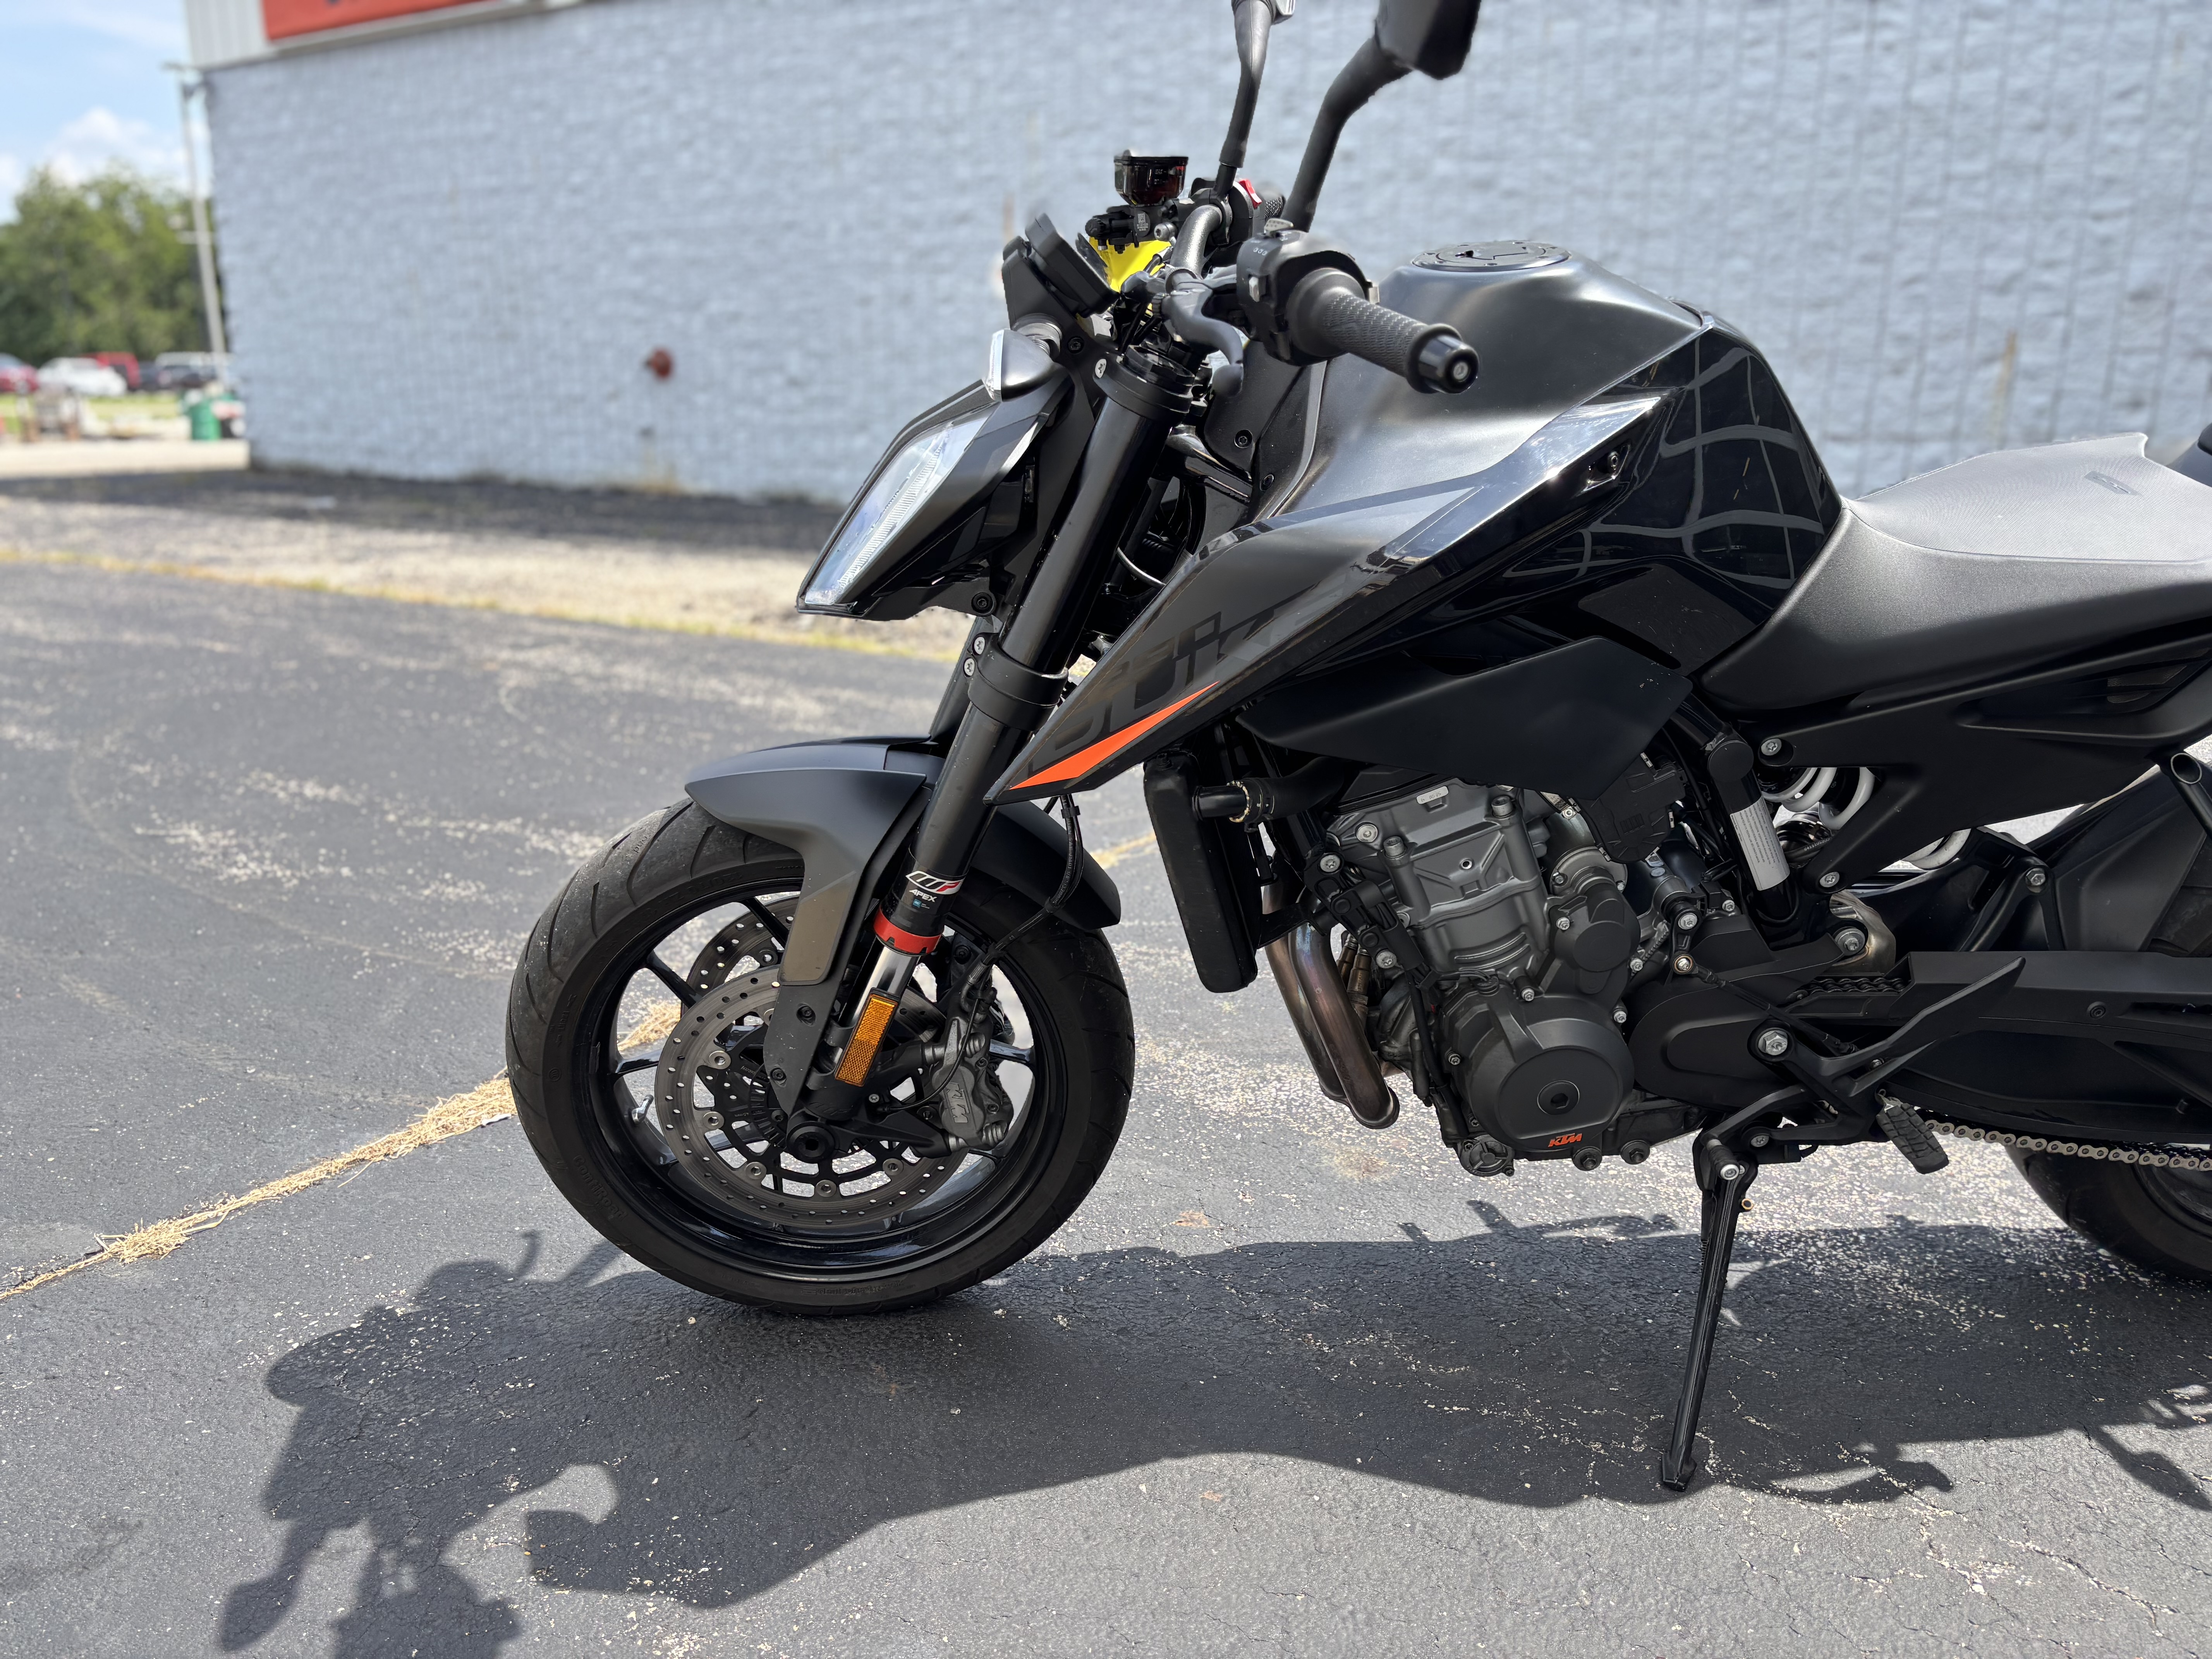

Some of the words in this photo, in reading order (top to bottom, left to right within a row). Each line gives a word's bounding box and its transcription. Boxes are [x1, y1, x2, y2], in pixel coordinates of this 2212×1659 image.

[909, 889, 938, 903] APEX
[945, 1082, 970, 1123] KTM
[1547, 1133, 1582, 1147] KTM
[573, 1154, 629, 1221] ContiRoad
